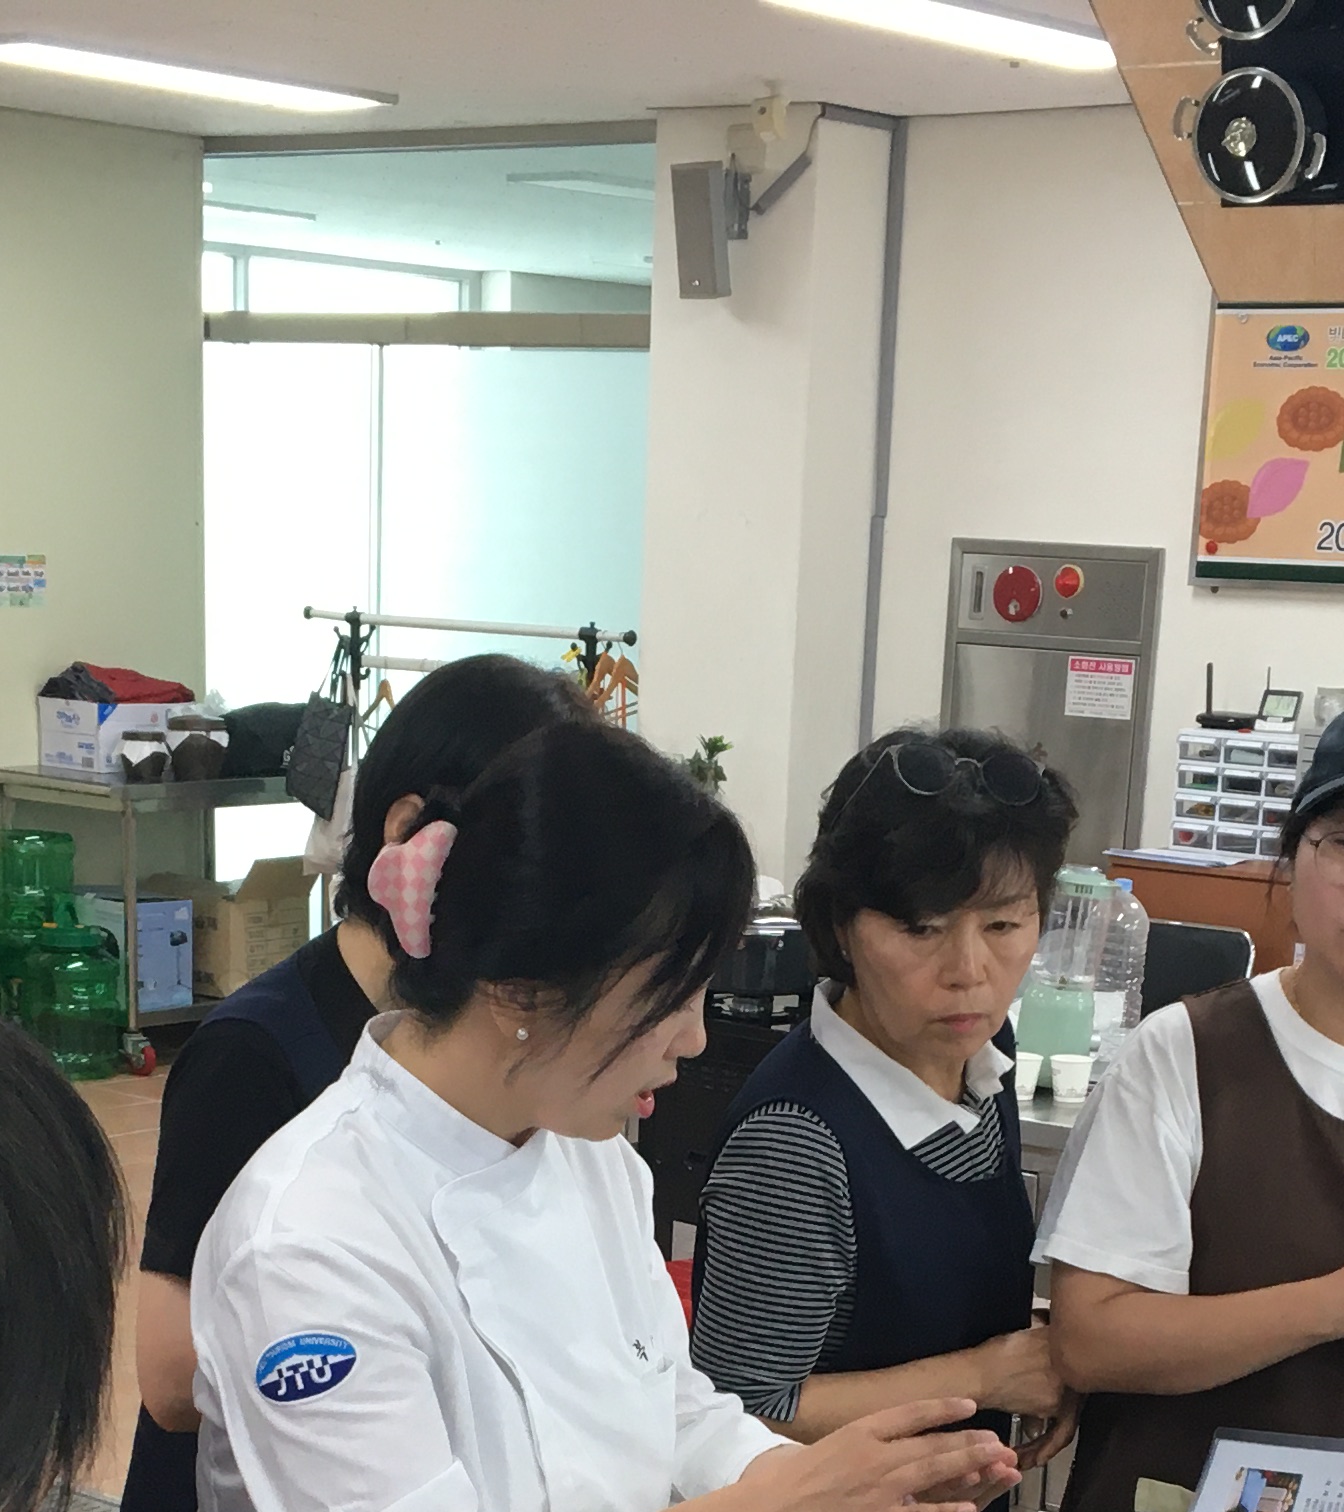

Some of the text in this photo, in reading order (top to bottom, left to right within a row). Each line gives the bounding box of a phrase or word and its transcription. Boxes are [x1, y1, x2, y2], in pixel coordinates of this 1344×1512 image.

[1276, 334, 1300, 343] APEC
[299, 1336, 348, 1350] UNIVERSITY
[276, 1354, 333, 1397] JTU
